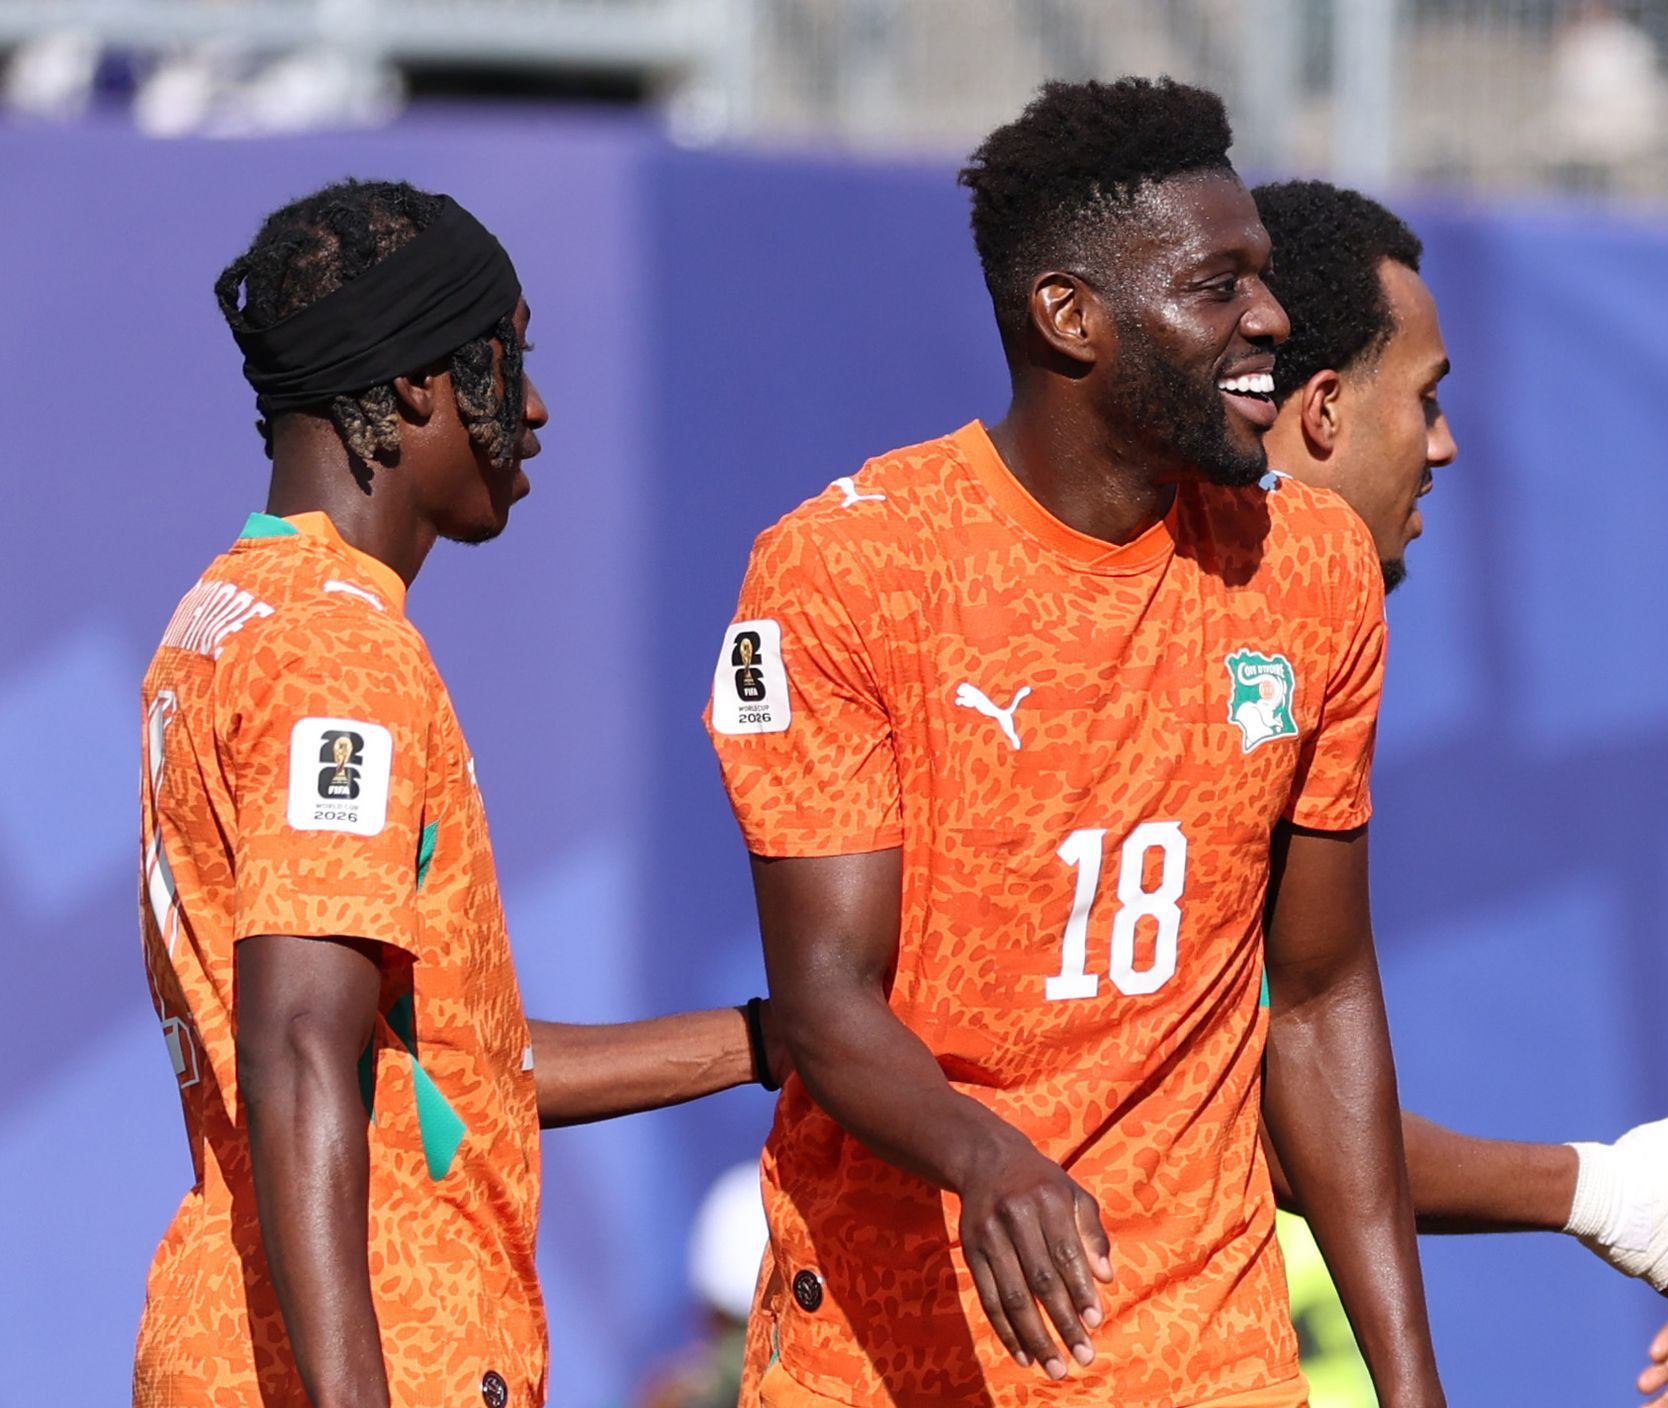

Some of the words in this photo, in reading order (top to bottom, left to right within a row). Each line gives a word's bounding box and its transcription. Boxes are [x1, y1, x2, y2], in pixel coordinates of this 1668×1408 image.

[738, 712, 771, 724] 2026
[313, 811, 359, 823] 2026
[1043, 820, 1188, 1001] 18
